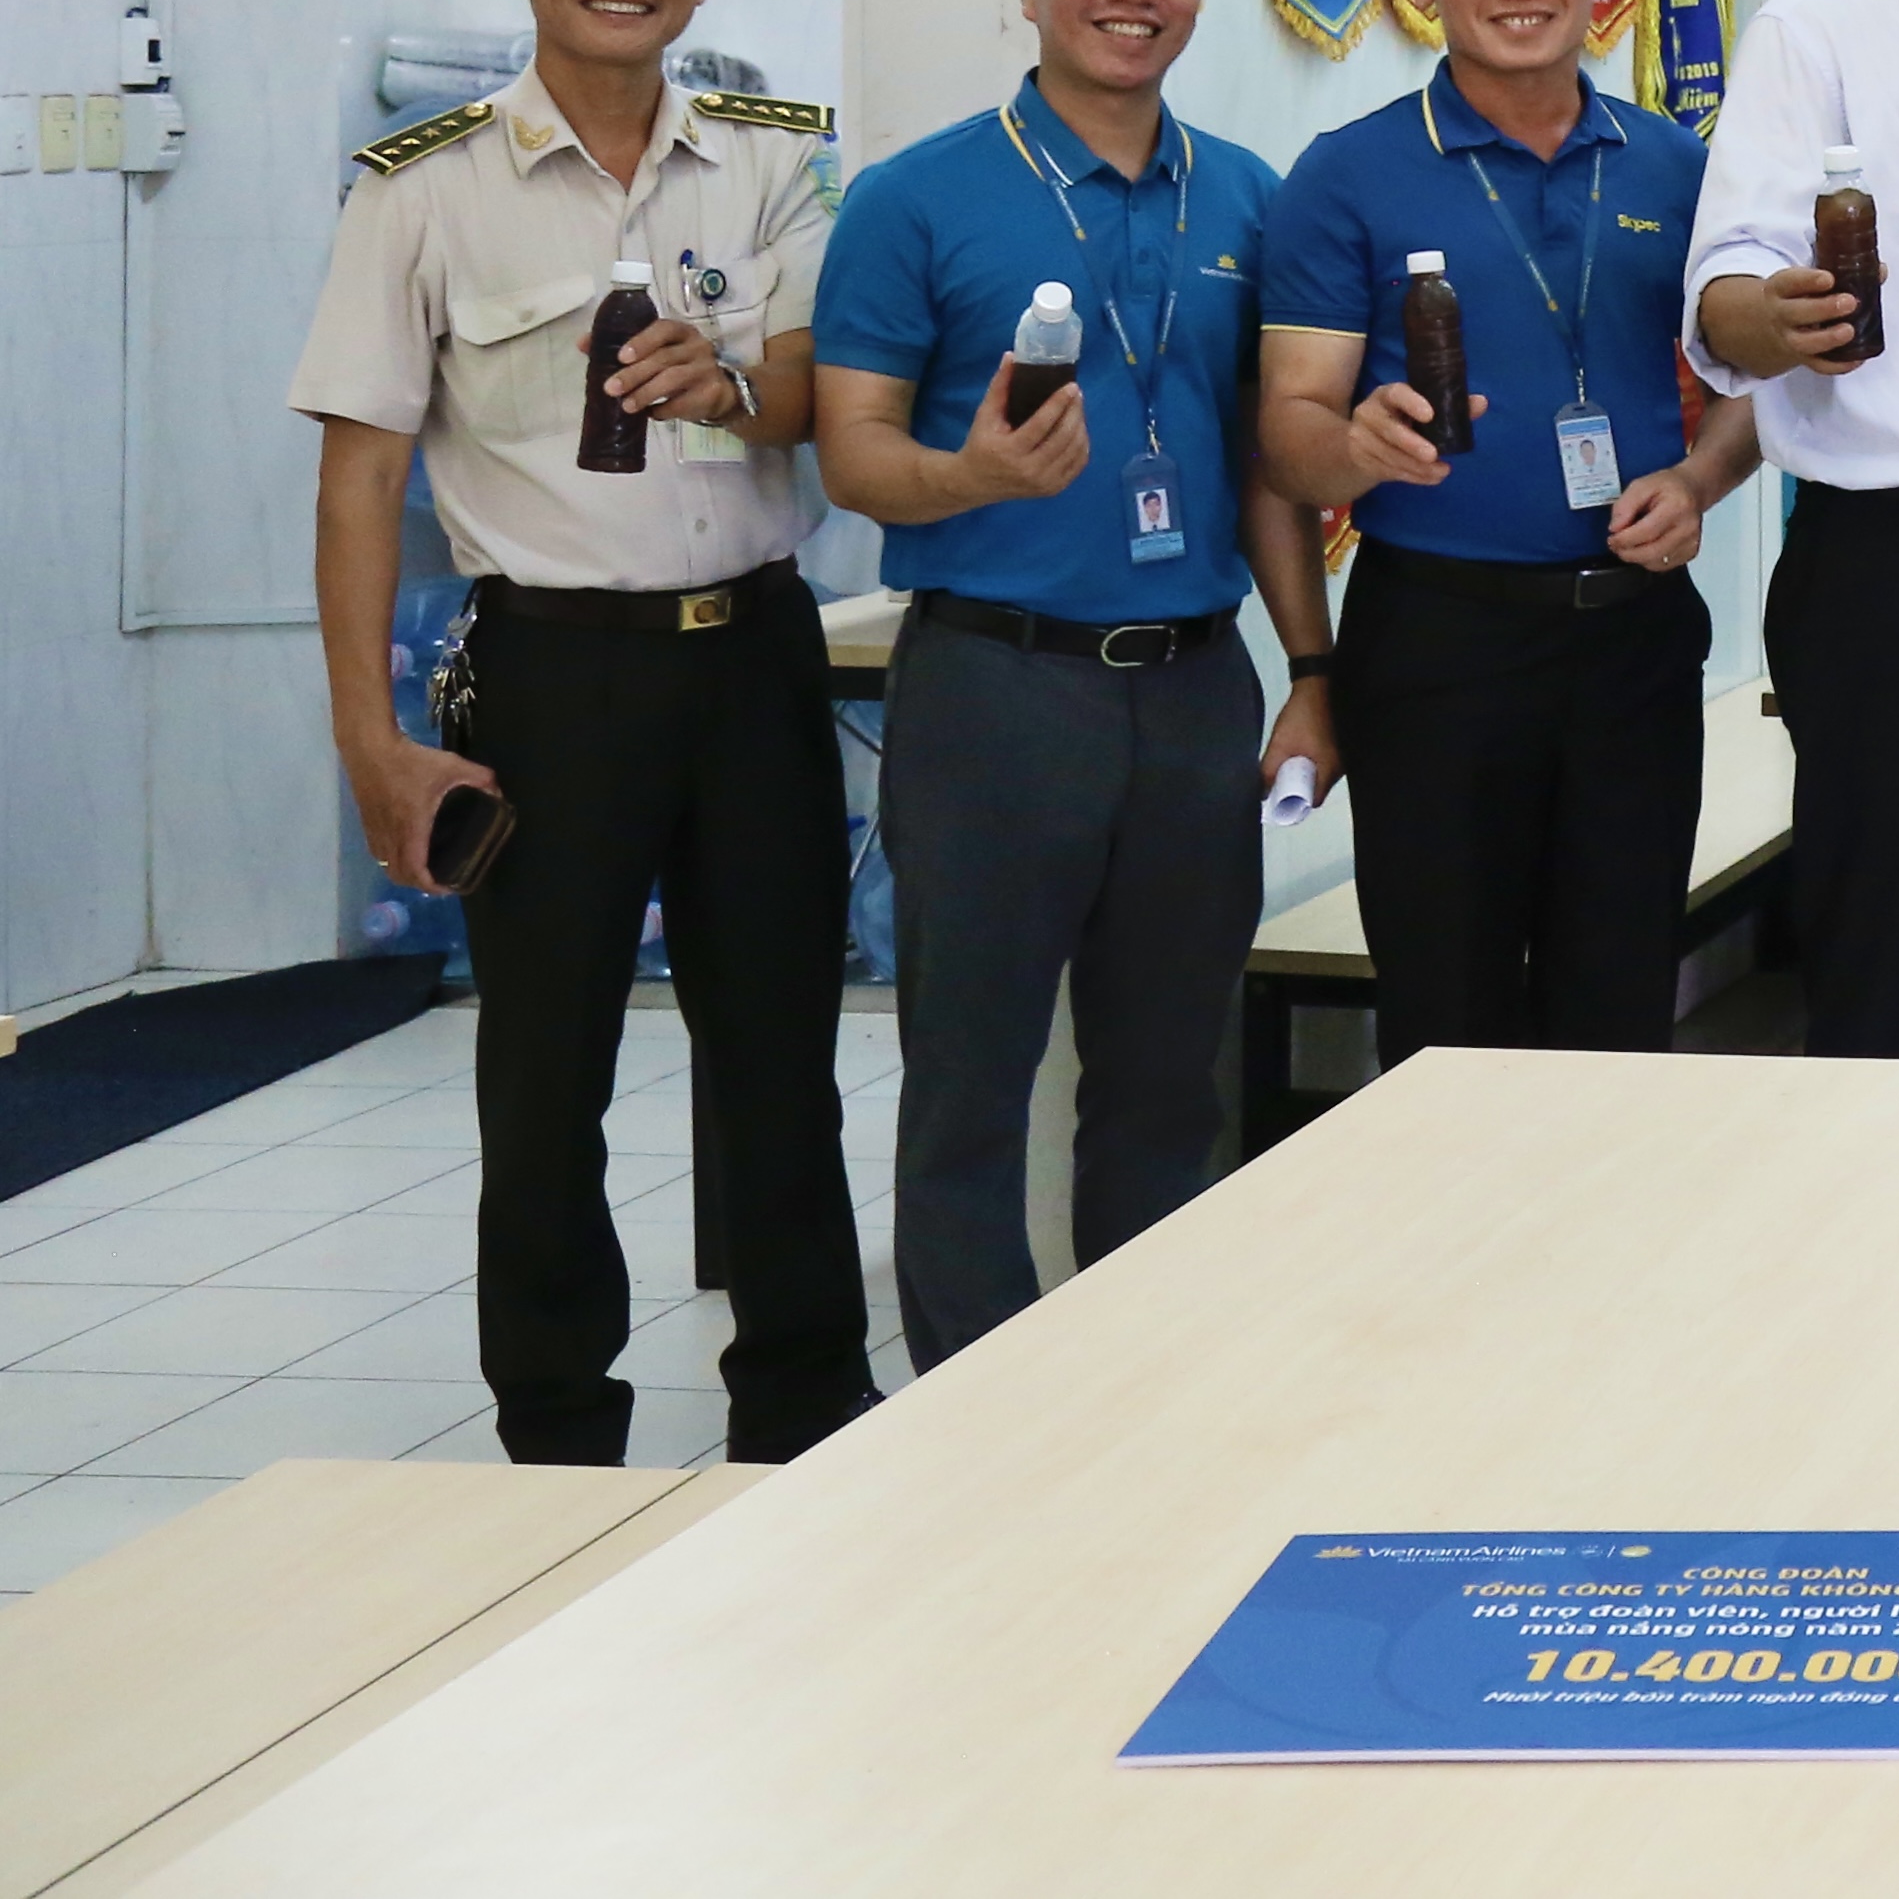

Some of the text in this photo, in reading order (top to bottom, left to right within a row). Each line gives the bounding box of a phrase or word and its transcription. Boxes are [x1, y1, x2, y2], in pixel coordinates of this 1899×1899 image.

[1617, 214, 1661, 233] Skypec
[1683, 1566, 1869, 1580] CÔNG ĐOÀN
[1461, 1580, 1547, 1597] TỔNG
[1557, 1582, 1644, 1597] CÔNG
[1655, 1583, 1693, 1597] TY
[1701, 1582, 1790, 1597] HÀNG
[1472, 1602, 1519, 1618] Hỗ
[1528, 1603, 1582, 1619] trợ
[1588, 1603, 1677, 1618] đoàn
[1687, 1603, 1770, 1620] viên,
[1780, 1603, 1881, 1619] người
[1519, 1621, 1597, 1636] mùa
[1607, 1620, 1697, 1638] nắng
[1705, 1621, 1796, 1638] nóng
[1805, 1622, 1882, 1636] năm
